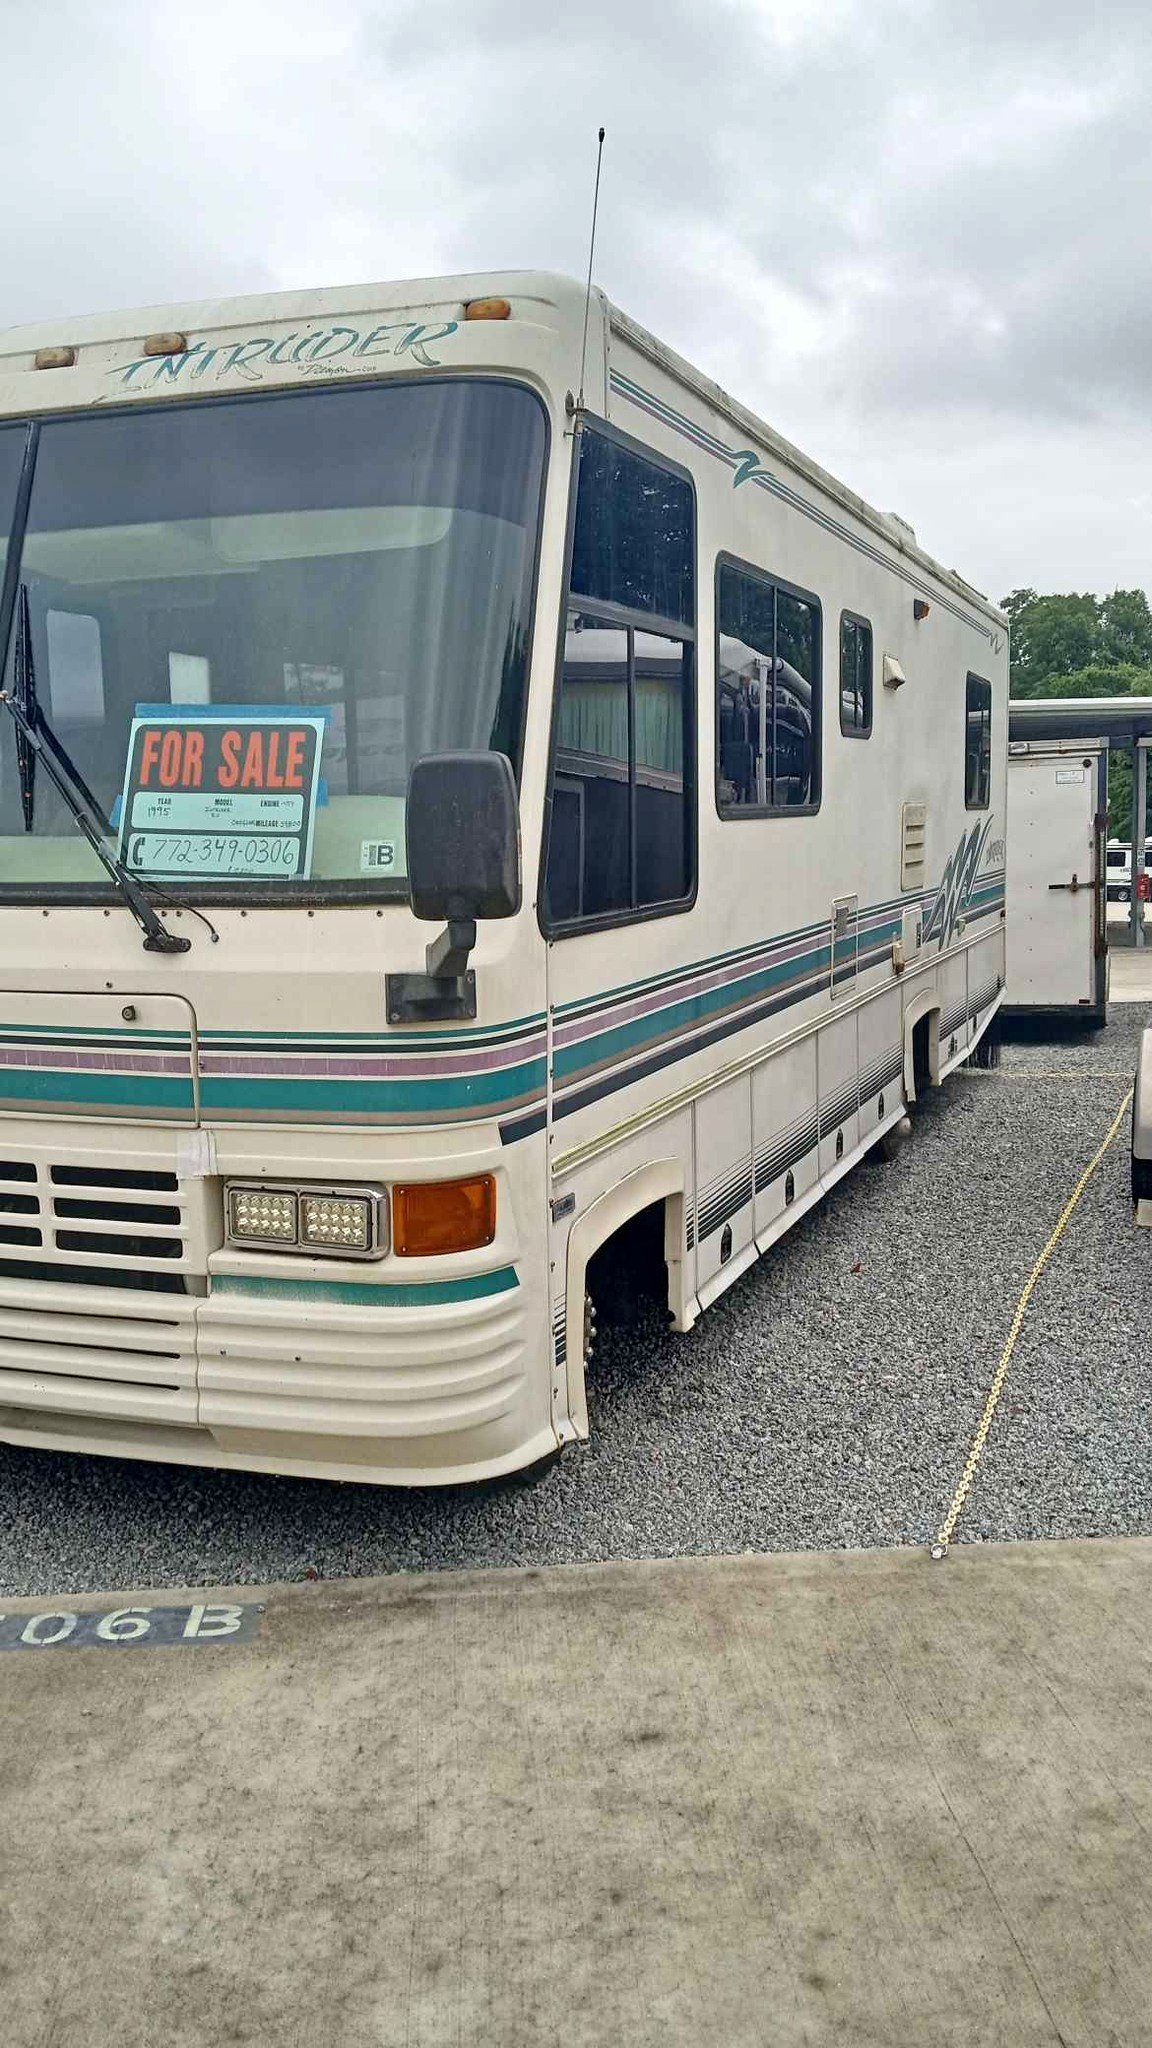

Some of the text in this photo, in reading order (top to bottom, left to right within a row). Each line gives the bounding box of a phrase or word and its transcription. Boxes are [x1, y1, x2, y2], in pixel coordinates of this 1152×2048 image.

[104, 322, 458, 391] INTRUDER
[139, 730, 306, 787] FOR SALE
[255, 819, 278, 827] MILEAGE
[153, 839, 294, 864] 772-349-0306
[377, 845, 393, 865] B
[0, 1604, 244, 1645] 06B
